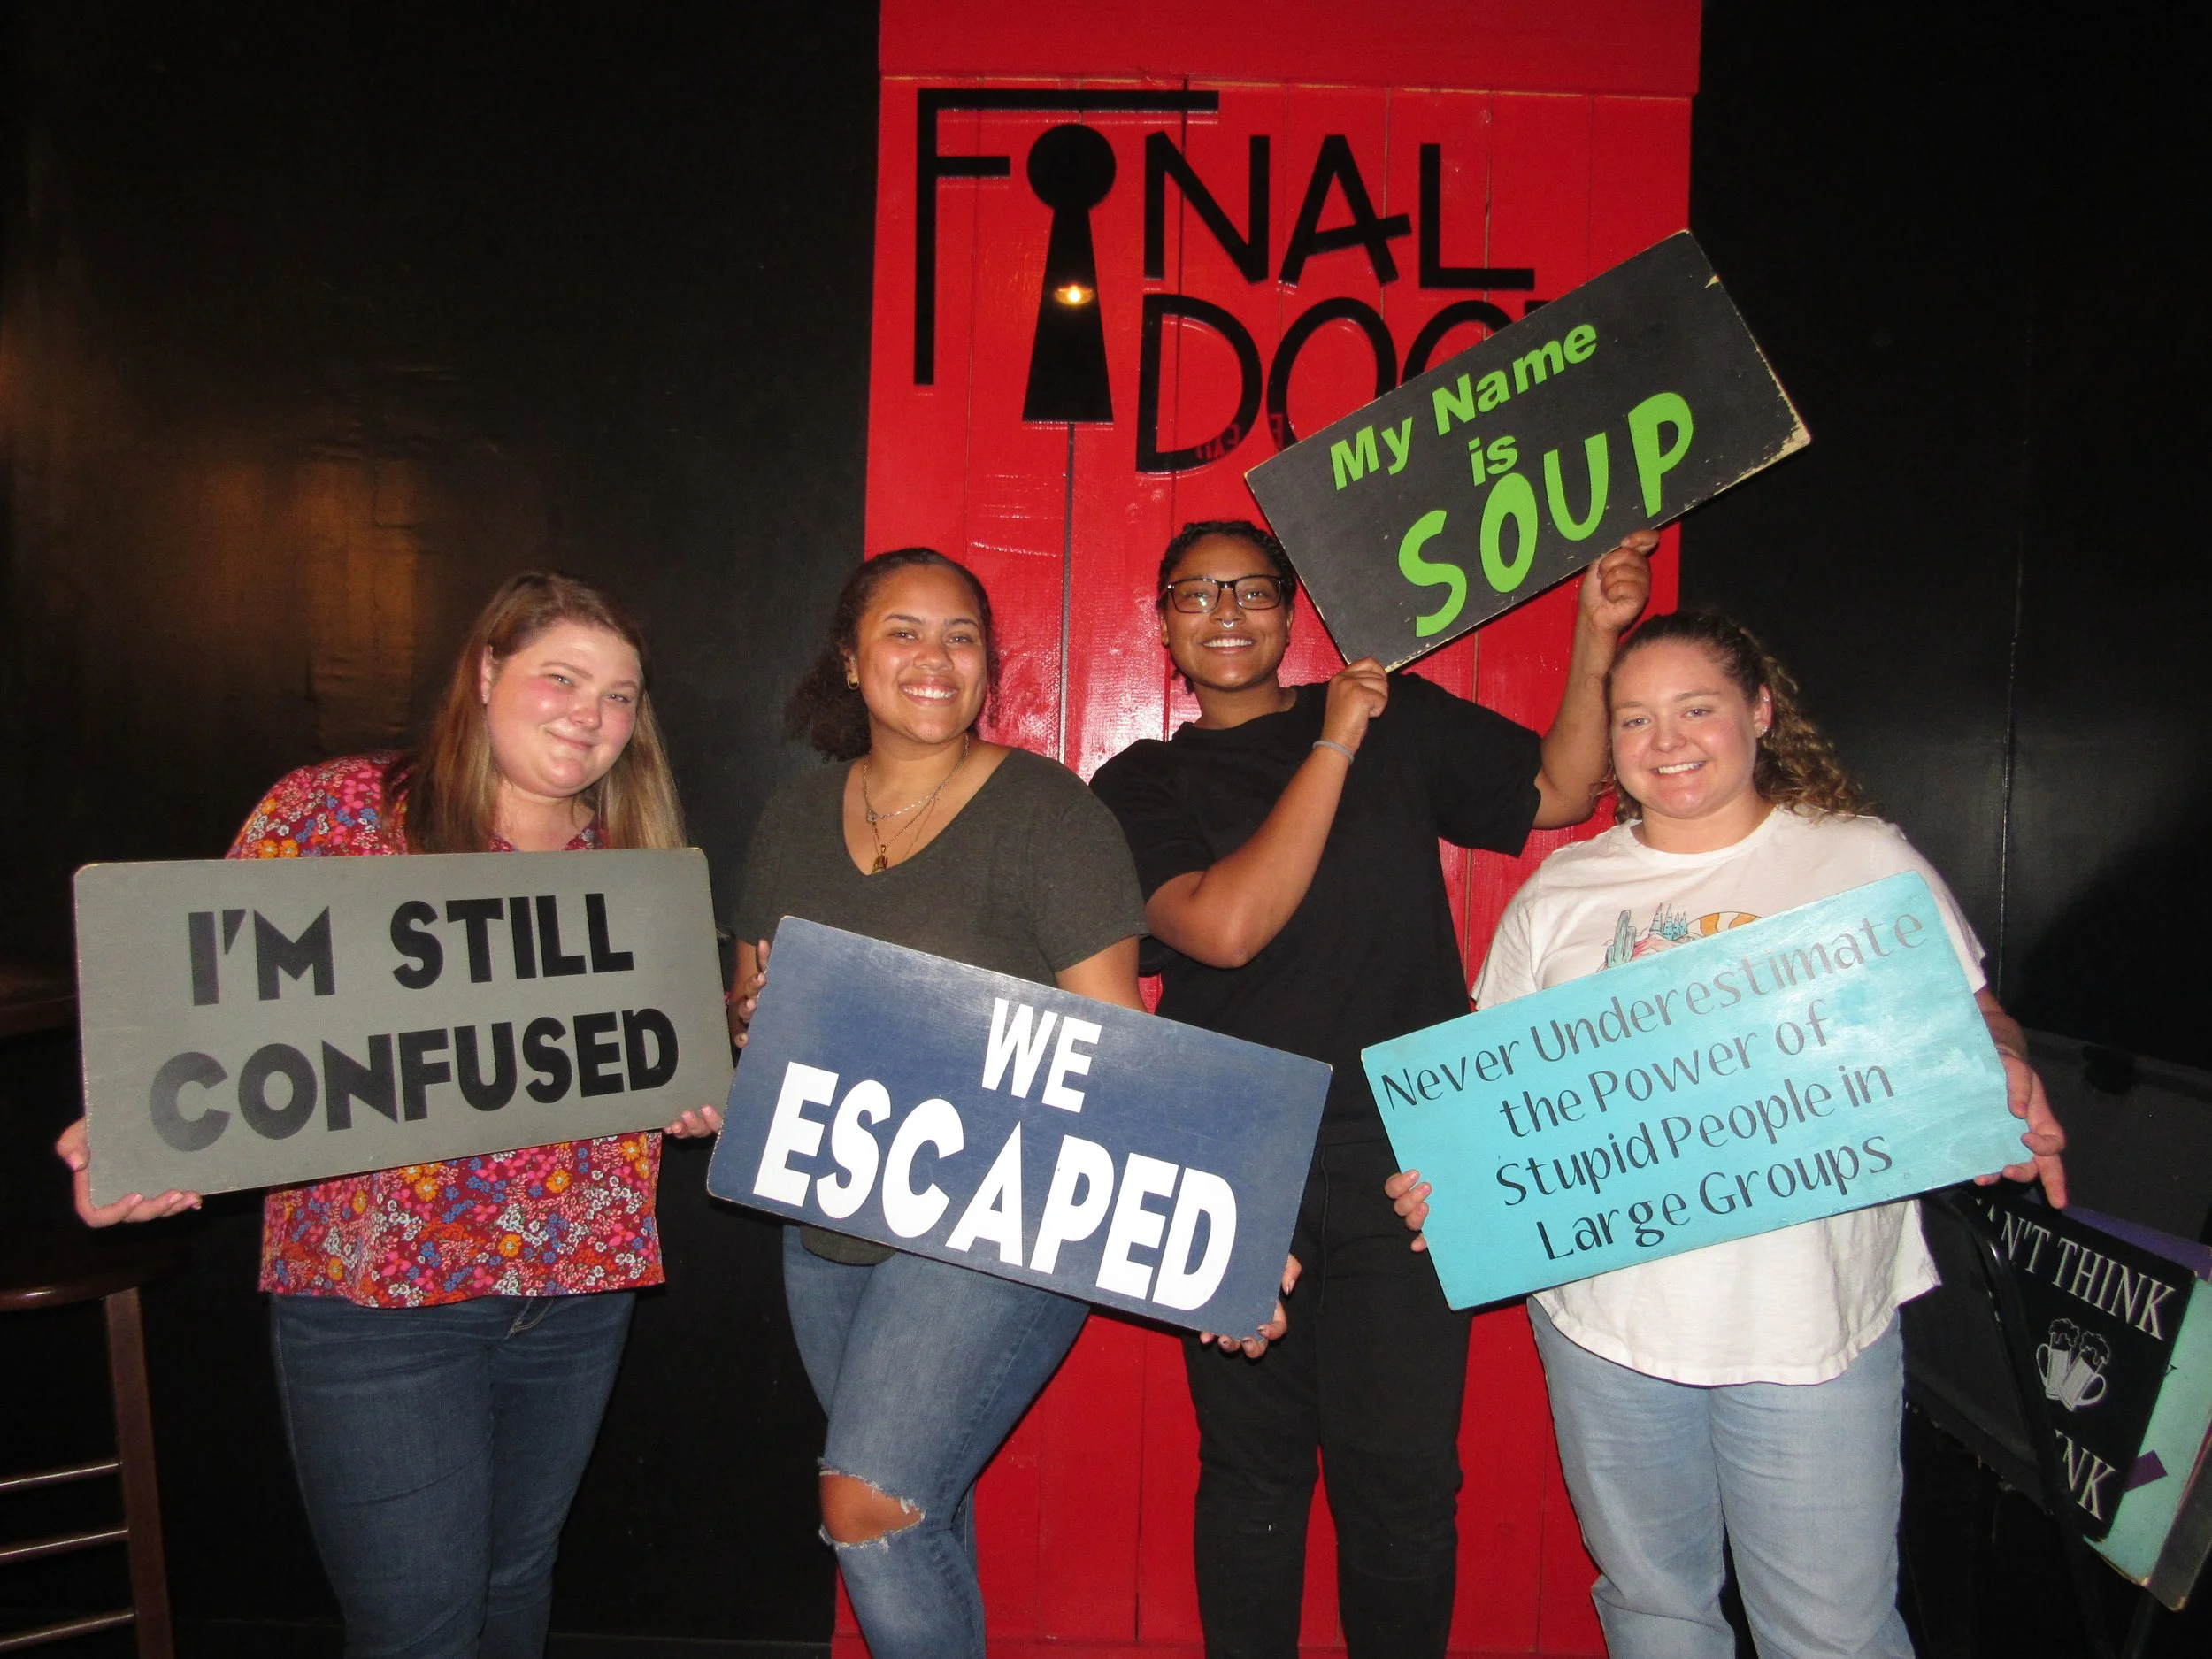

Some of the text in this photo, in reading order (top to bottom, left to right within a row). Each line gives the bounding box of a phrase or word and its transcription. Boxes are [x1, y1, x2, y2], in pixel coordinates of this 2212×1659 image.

[1330, 417, 1413, 490] My
[1432, 324, 1597, 436] Name
[1468, 434, 1518, 487] is
[1398, 392, 1694, 638] SOUP
[188, 892, 634, 1006] I'M STILL
[1379, 911, 1924, 1112] Never Underestimate
[150, 1008, 679, 1152] CONFUSED
[981, 996, 1102, 1113] WE
[1499, 1000, 1830, 1138] the Power of
[752, 1061, 1237, 1310] ESCAPED
[1495, 1064, 1894, 1207] Stupid People in
[1535, 1135, 1893, 1261] Large Groups
[2051, 1236, 2176, 1341] THINK
